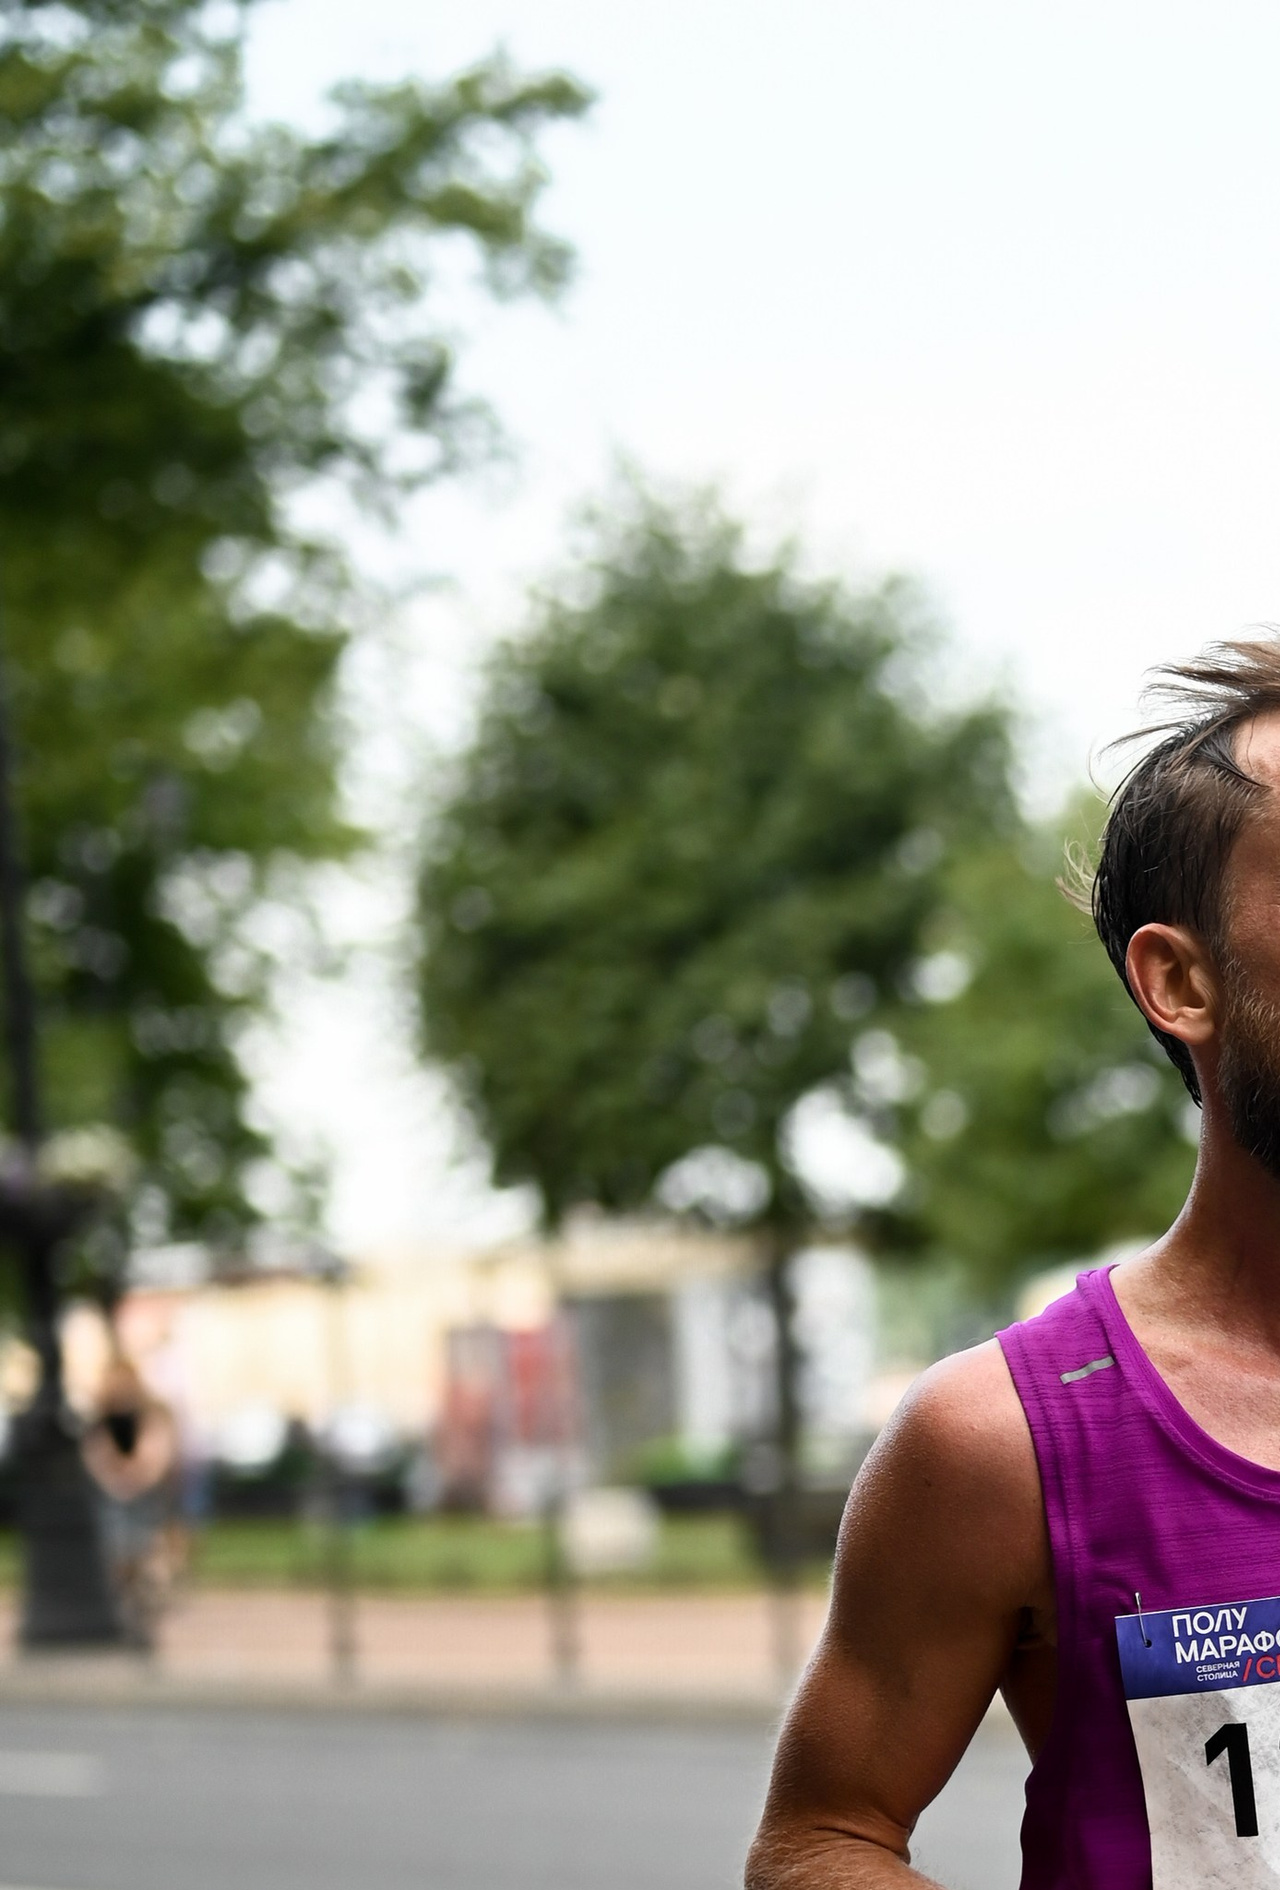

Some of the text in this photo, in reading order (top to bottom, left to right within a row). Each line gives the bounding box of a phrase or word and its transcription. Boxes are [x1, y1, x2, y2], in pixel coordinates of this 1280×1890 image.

[1172, 1607, 1247, 1637] ПОЛУ
[1196, 1661, 1240, 1673] СЕВЕРНАЯ
[1197, 1670, 1238, 1682] СТОЛИЦА
